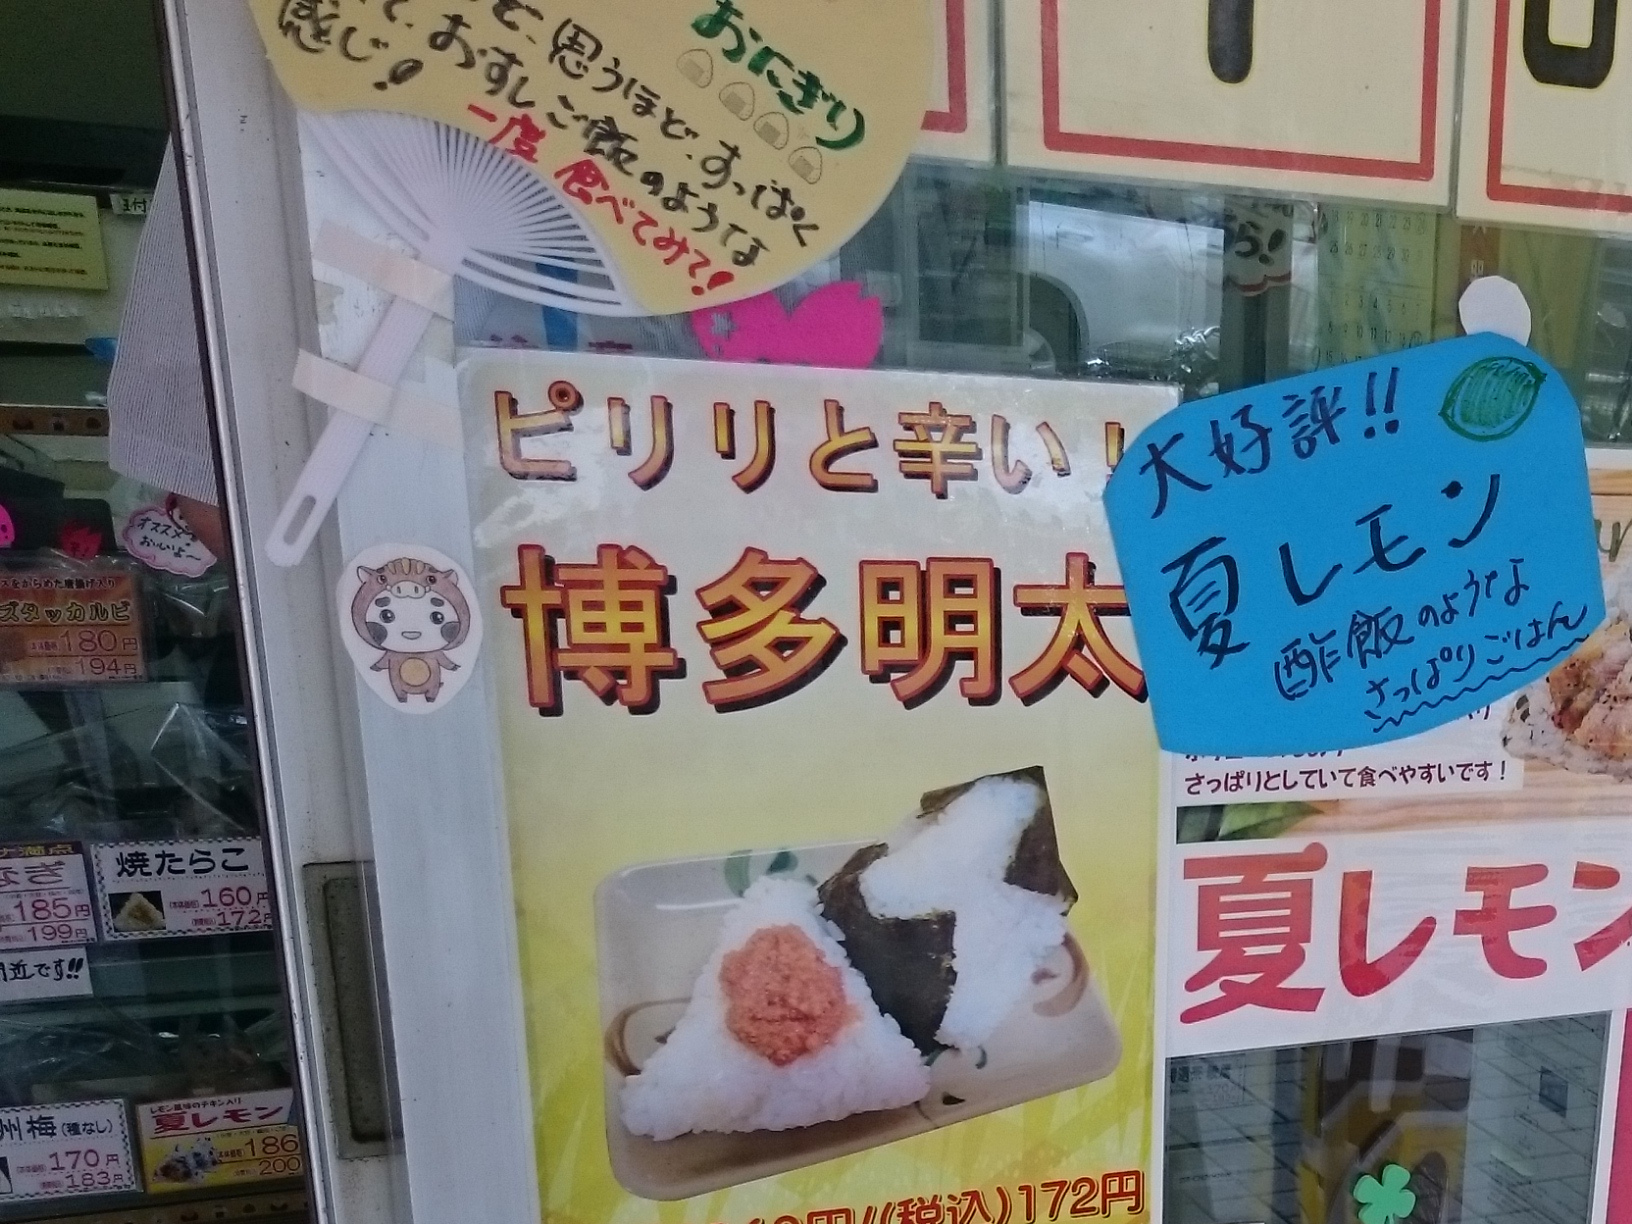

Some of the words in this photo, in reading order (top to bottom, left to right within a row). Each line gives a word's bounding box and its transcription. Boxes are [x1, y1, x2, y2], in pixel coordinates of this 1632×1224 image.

[692, 0, 867, 150] おにぎり
[468, 104, 546, 163] 一度
[554, 159, 734, 295] 食べてみて!
[1141, 366, 1400, 519] 大好評!!
[1161, 474, 1502, 670] 夏レモン
[61, 630, 138, 653] 180円
[501, 544, 1148, 717] 博多明太
[1276, 558, 1529, 701] 酢飯のような
[75, 658, 137, 676] 194円
[1364, 602, 1588, 719] さっぱりごはん
[1185, 761, 1507, 795] さっぱりとしていて食べやすいです!
[116, 848, 249, 878] 焼たらこ
[15, 897, 92, 922] 185円
[201, 886, 268, 907] 160円
[28, 923, 88, 942] 199円
[154, 1106, 283, 1134] 夏レモン
[245, 1133, 299, 1157] 186
[50, 1148, 120, 1172] 170円
[65, 1172, 124, 1190] 183円
